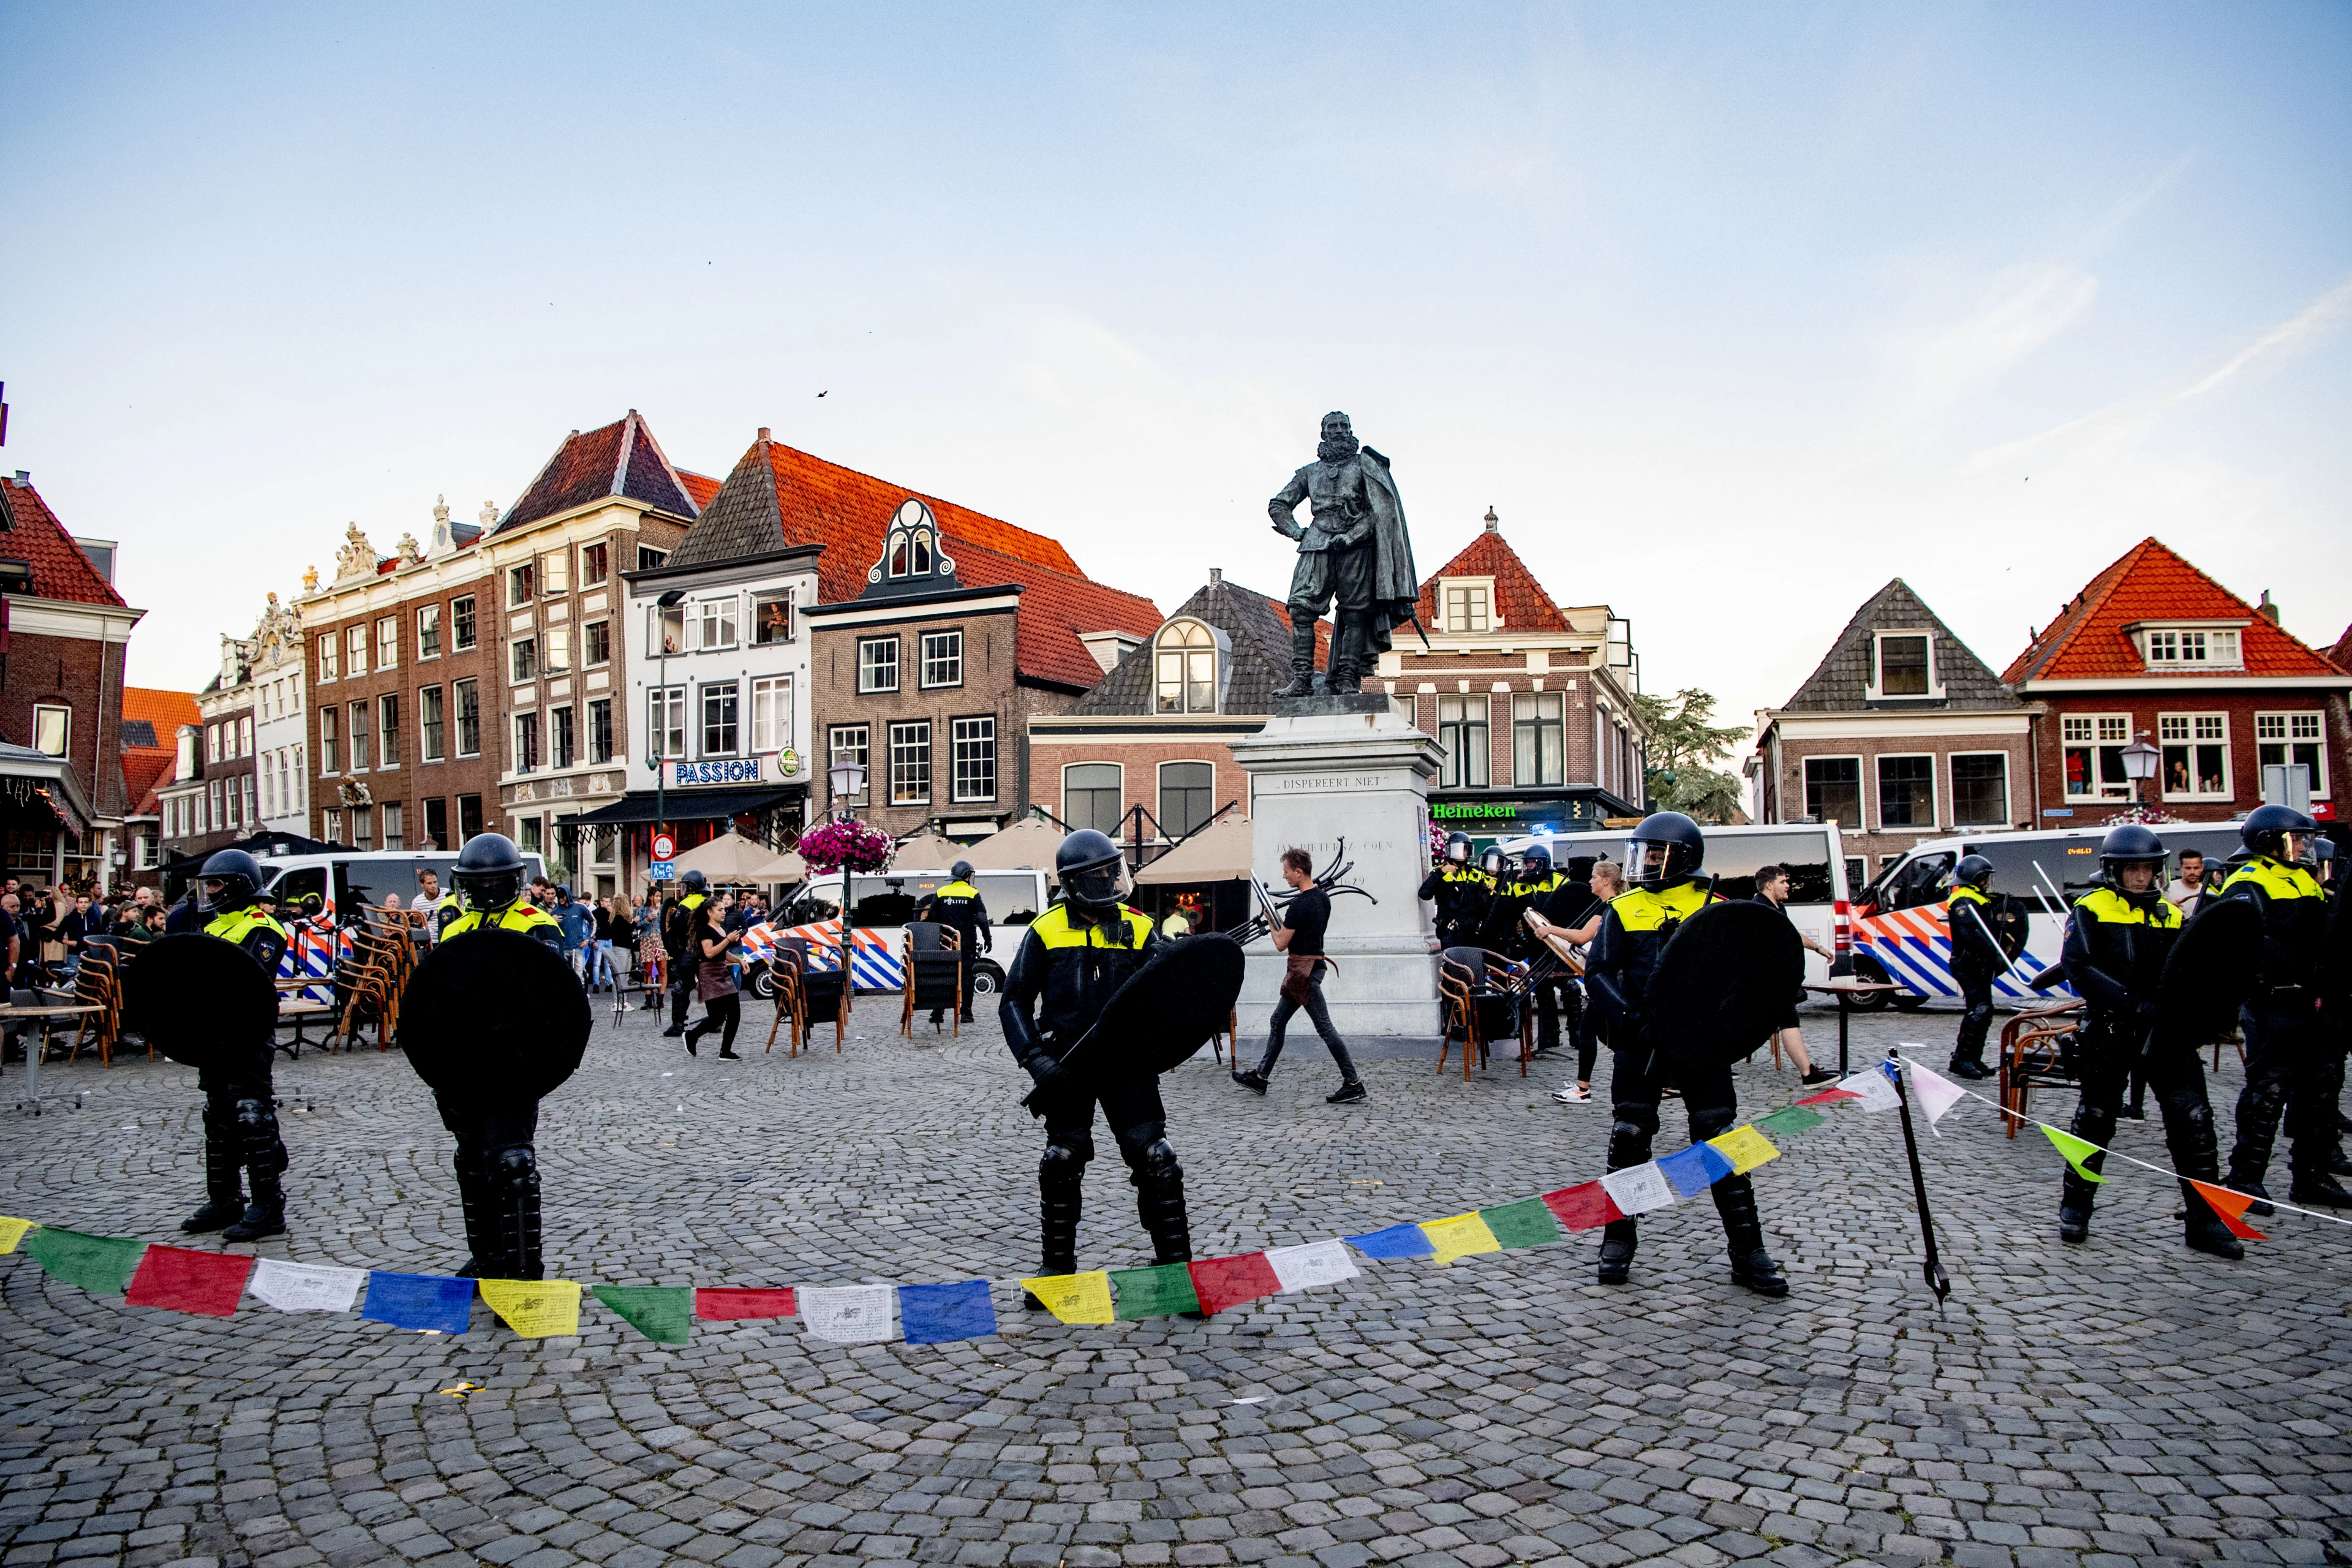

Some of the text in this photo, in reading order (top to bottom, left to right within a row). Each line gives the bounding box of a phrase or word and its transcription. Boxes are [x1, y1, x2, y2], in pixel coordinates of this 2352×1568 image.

[677, 760, 758, 784] PASSION
[1433, 804, 1516, 818] Heineken
[1364, 841, 1392, 850] COEN
[1340, 876, 1365, 886] 1629
[944, 896, 968, 905] POLITIE
